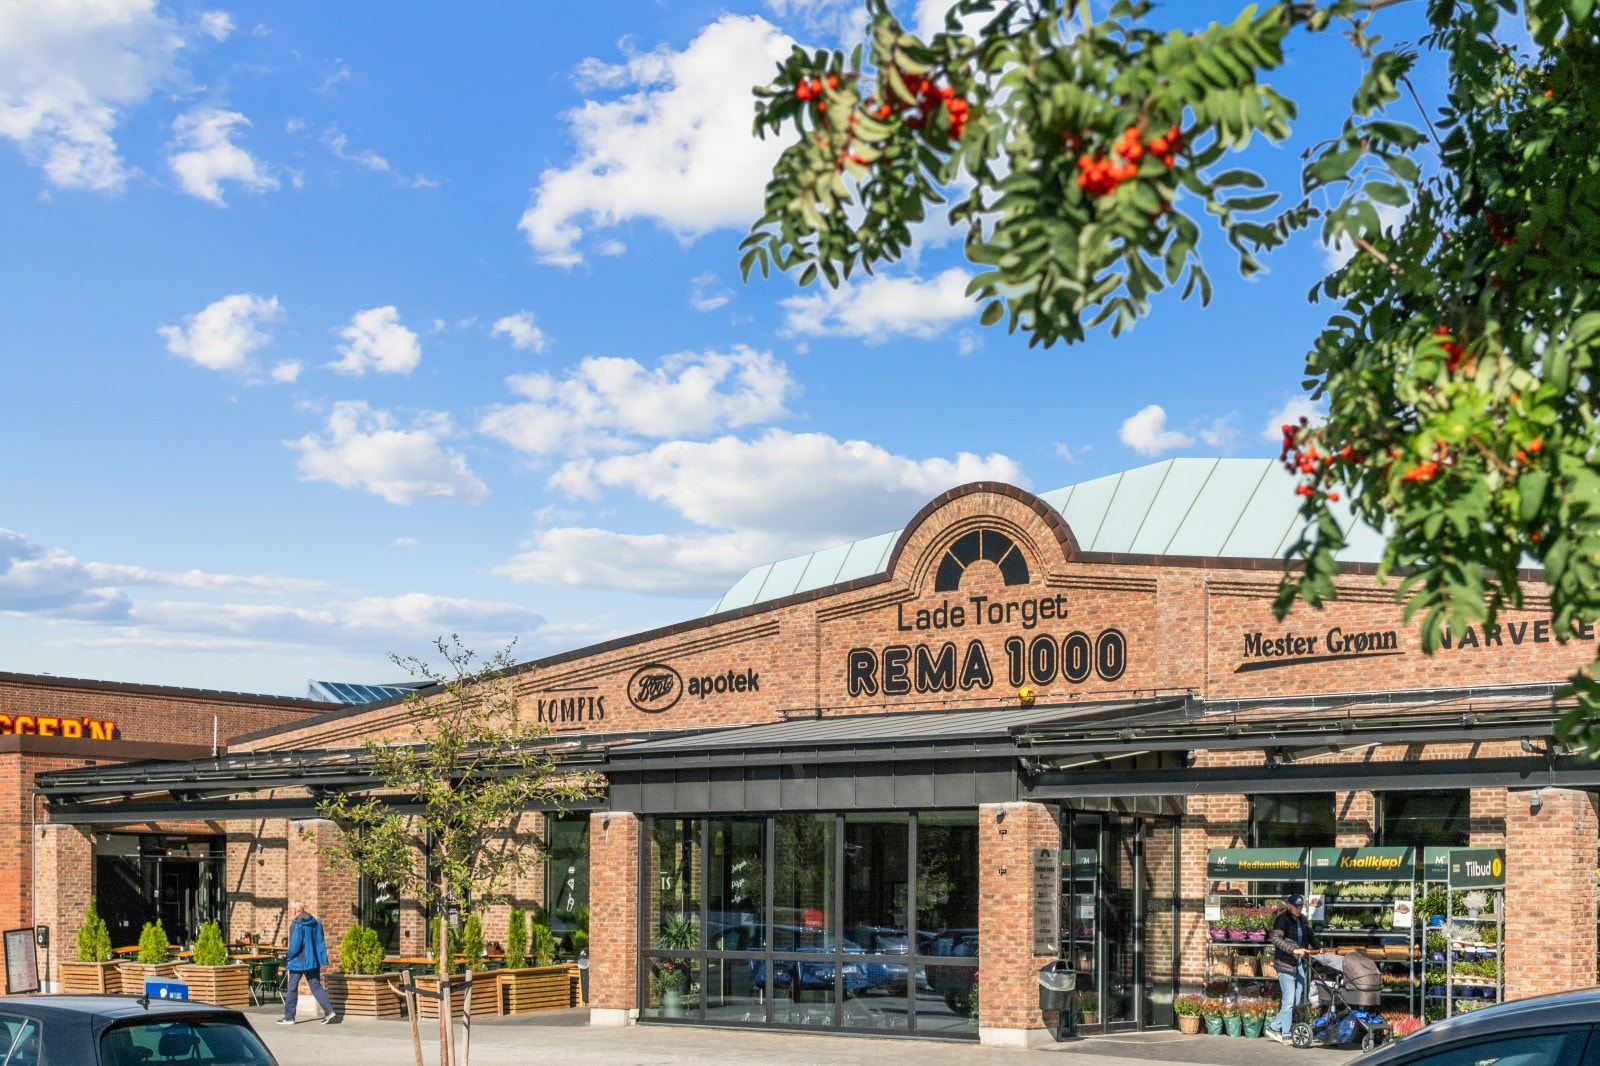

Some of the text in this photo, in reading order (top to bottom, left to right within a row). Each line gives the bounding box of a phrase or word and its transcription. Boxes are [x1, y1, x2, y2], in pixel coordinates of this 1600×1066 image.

[898, 593, 1068, 631] Lade Torget
[1243, 627, 1398, 657] Mester Grønn
[1439, 620, 1595, 650] NARVEE
[848, 628, 1127, 698] REMA 1000
[635, 668, 760, 703] Boots apotek
[537, 696, 605, 723] KOMPIS
[1238, 860, 1301, 869] Medlemstilbud
[1340, 855, 1403, 870] Knallkjøp!
[1465, 861, 1492, 877] Tilbud
